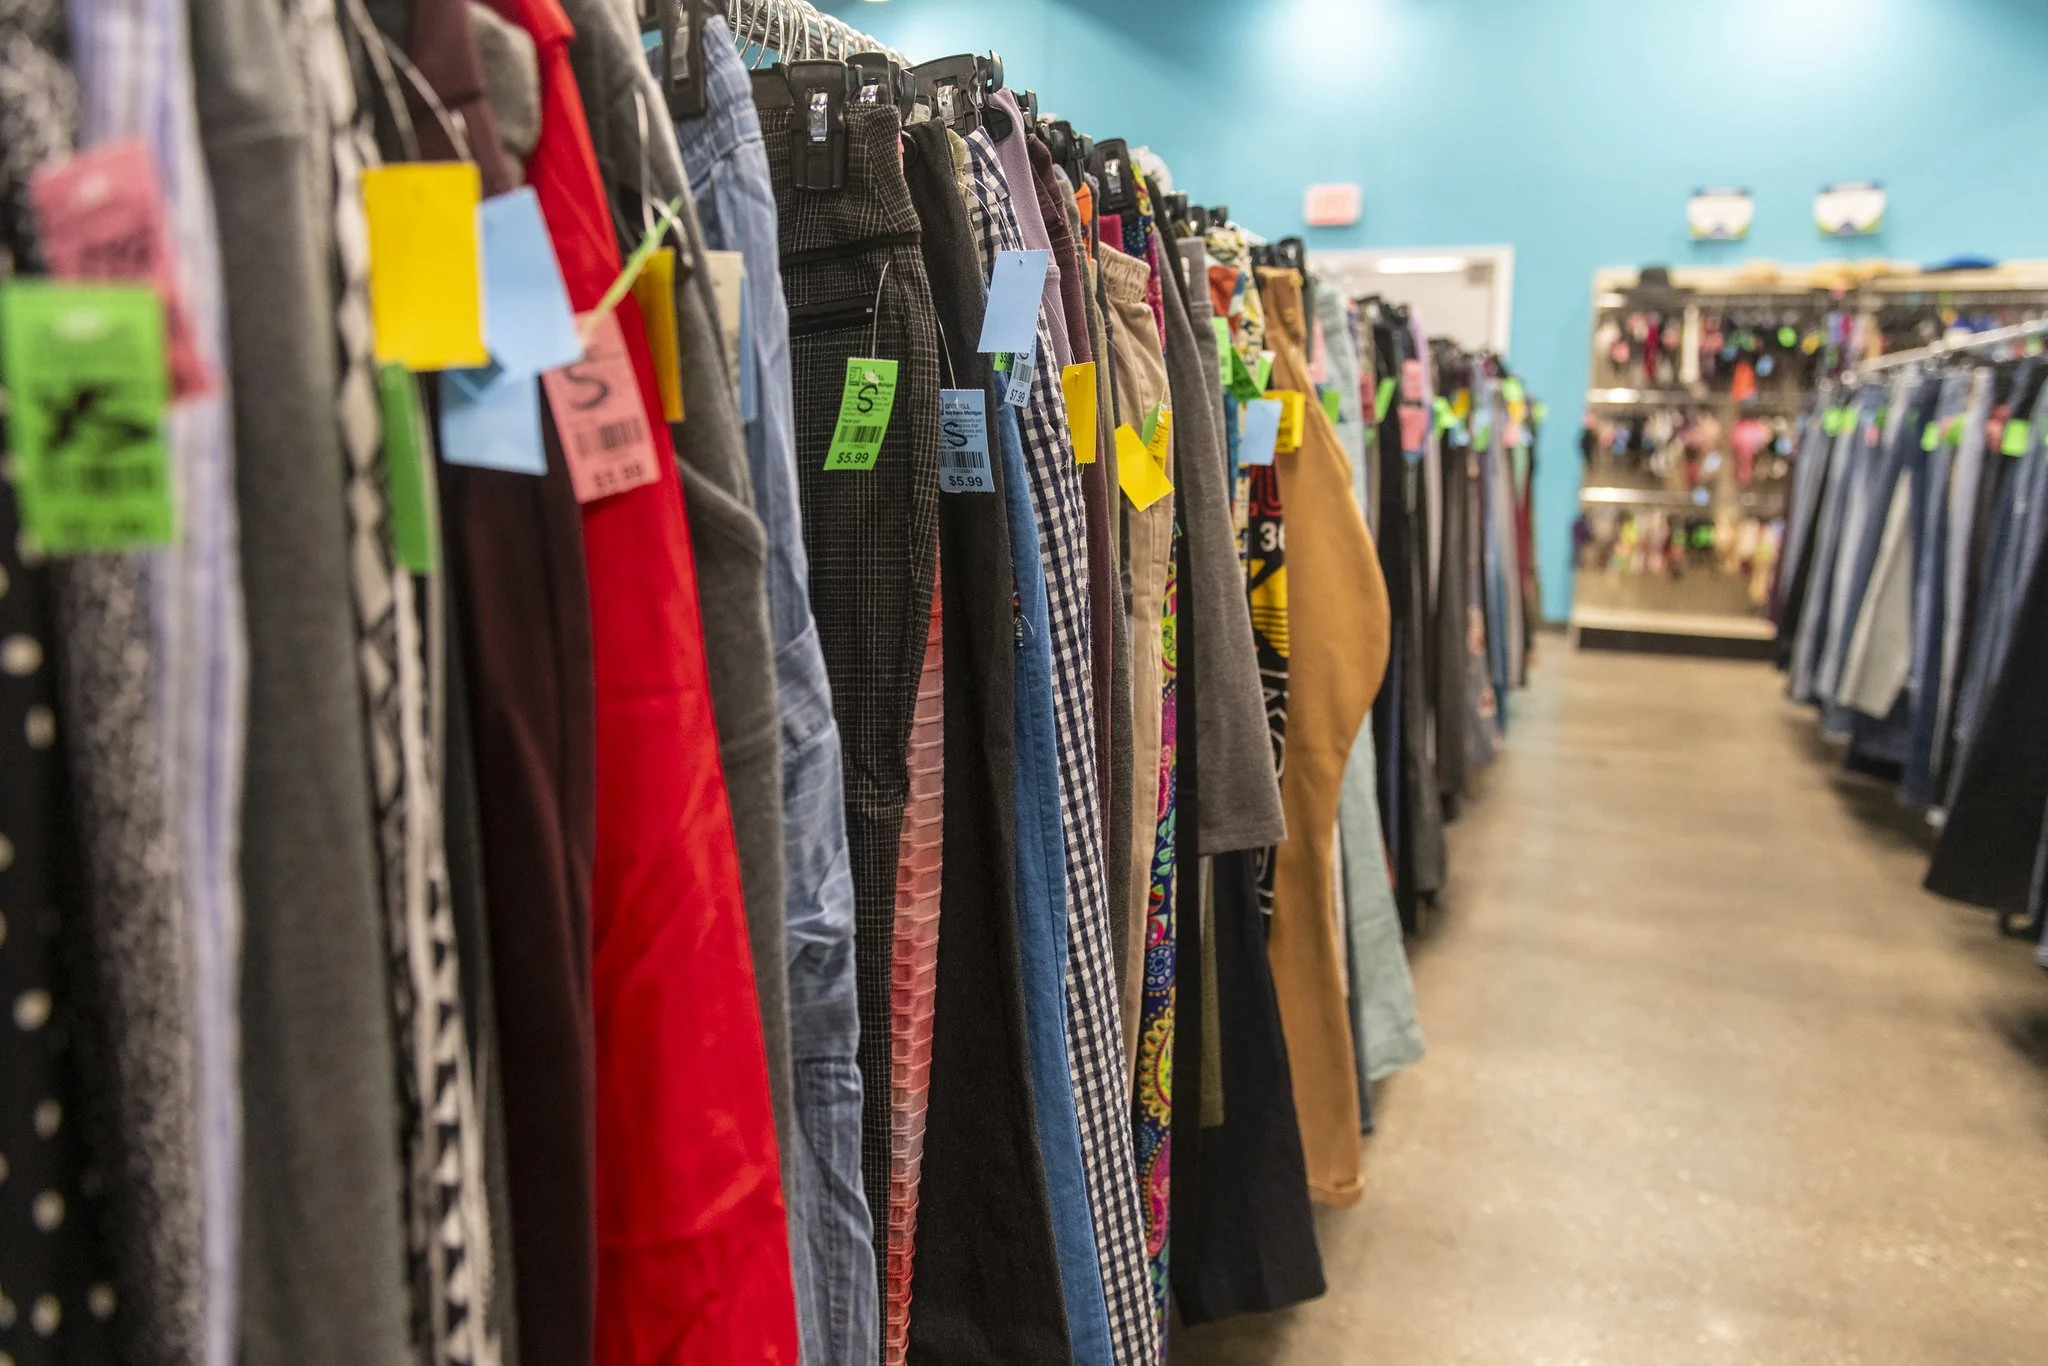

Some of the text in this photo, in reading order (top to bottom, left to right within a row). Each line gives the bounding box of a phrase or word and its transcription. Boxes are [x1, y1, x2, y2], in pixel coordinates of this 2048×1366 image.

[857, 384, 878, 413] S
[1009, 389, 1026, 403] $7.99
[943, 422, 968, 447] S
[836, 452, 869, 464] $5.99
[949, 475, 983, 488] $5.99
